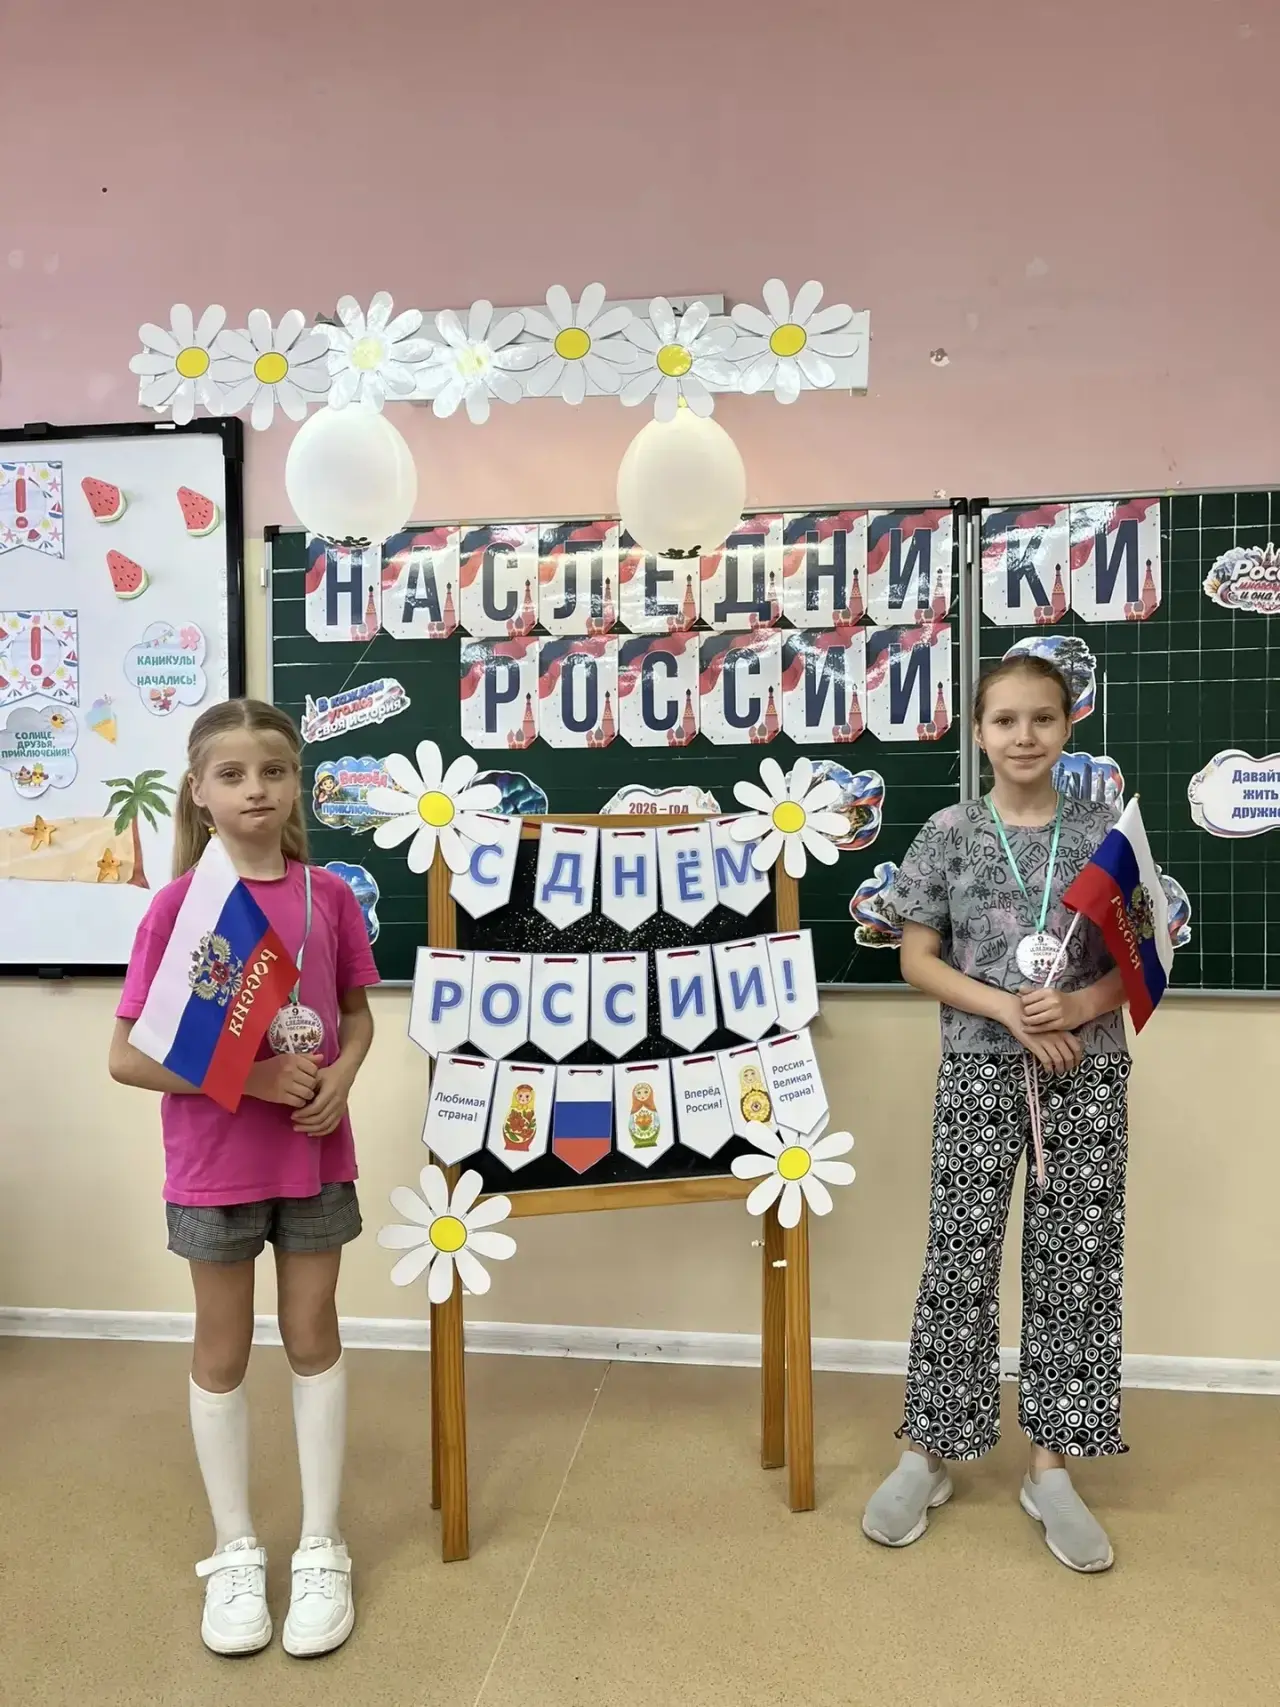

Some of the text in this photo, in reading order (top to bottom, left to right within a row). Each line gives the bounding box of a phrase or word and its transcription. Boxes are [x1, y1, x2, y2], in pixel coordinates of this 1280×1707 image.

[1230, 559, 1280, 581] Рос
[137, 655, 196, 666] КАНИКУЛЫ
[137, 674, 196, 686] НАЧАЛИСЬ!
[484, 642, 932, 734] РОССИИ
[15, 731, 55, 740] СОЛНЦЕ,
[17, 740, 56, 750] ДРУЗЬЯ,
[1, 748, 71, 758] ПРИКЛЮЧЕНИЯ!
[1243, 789, 1279, 800] жить
[629, 802, 658, 814] 2026
[668, 804, 690, 814] год
[469, 843, 764, 905] С ДНЁМ
[429, 958, 797, 1026] РОССИИ!
[292, 1007, 299, 1016] 9
[772, 1060, 805, 1075] Россия
[773, 1072, 813, 1090] Великая
[434, 1091, 486, 1108] Любимая
[684, 1086, 721, 1100] Вперёд
[779, 1087, 815, 1103] страна!
[686, 1099, 723, 1113] Россия!
[438, 1109, 478, 1122] страна!
